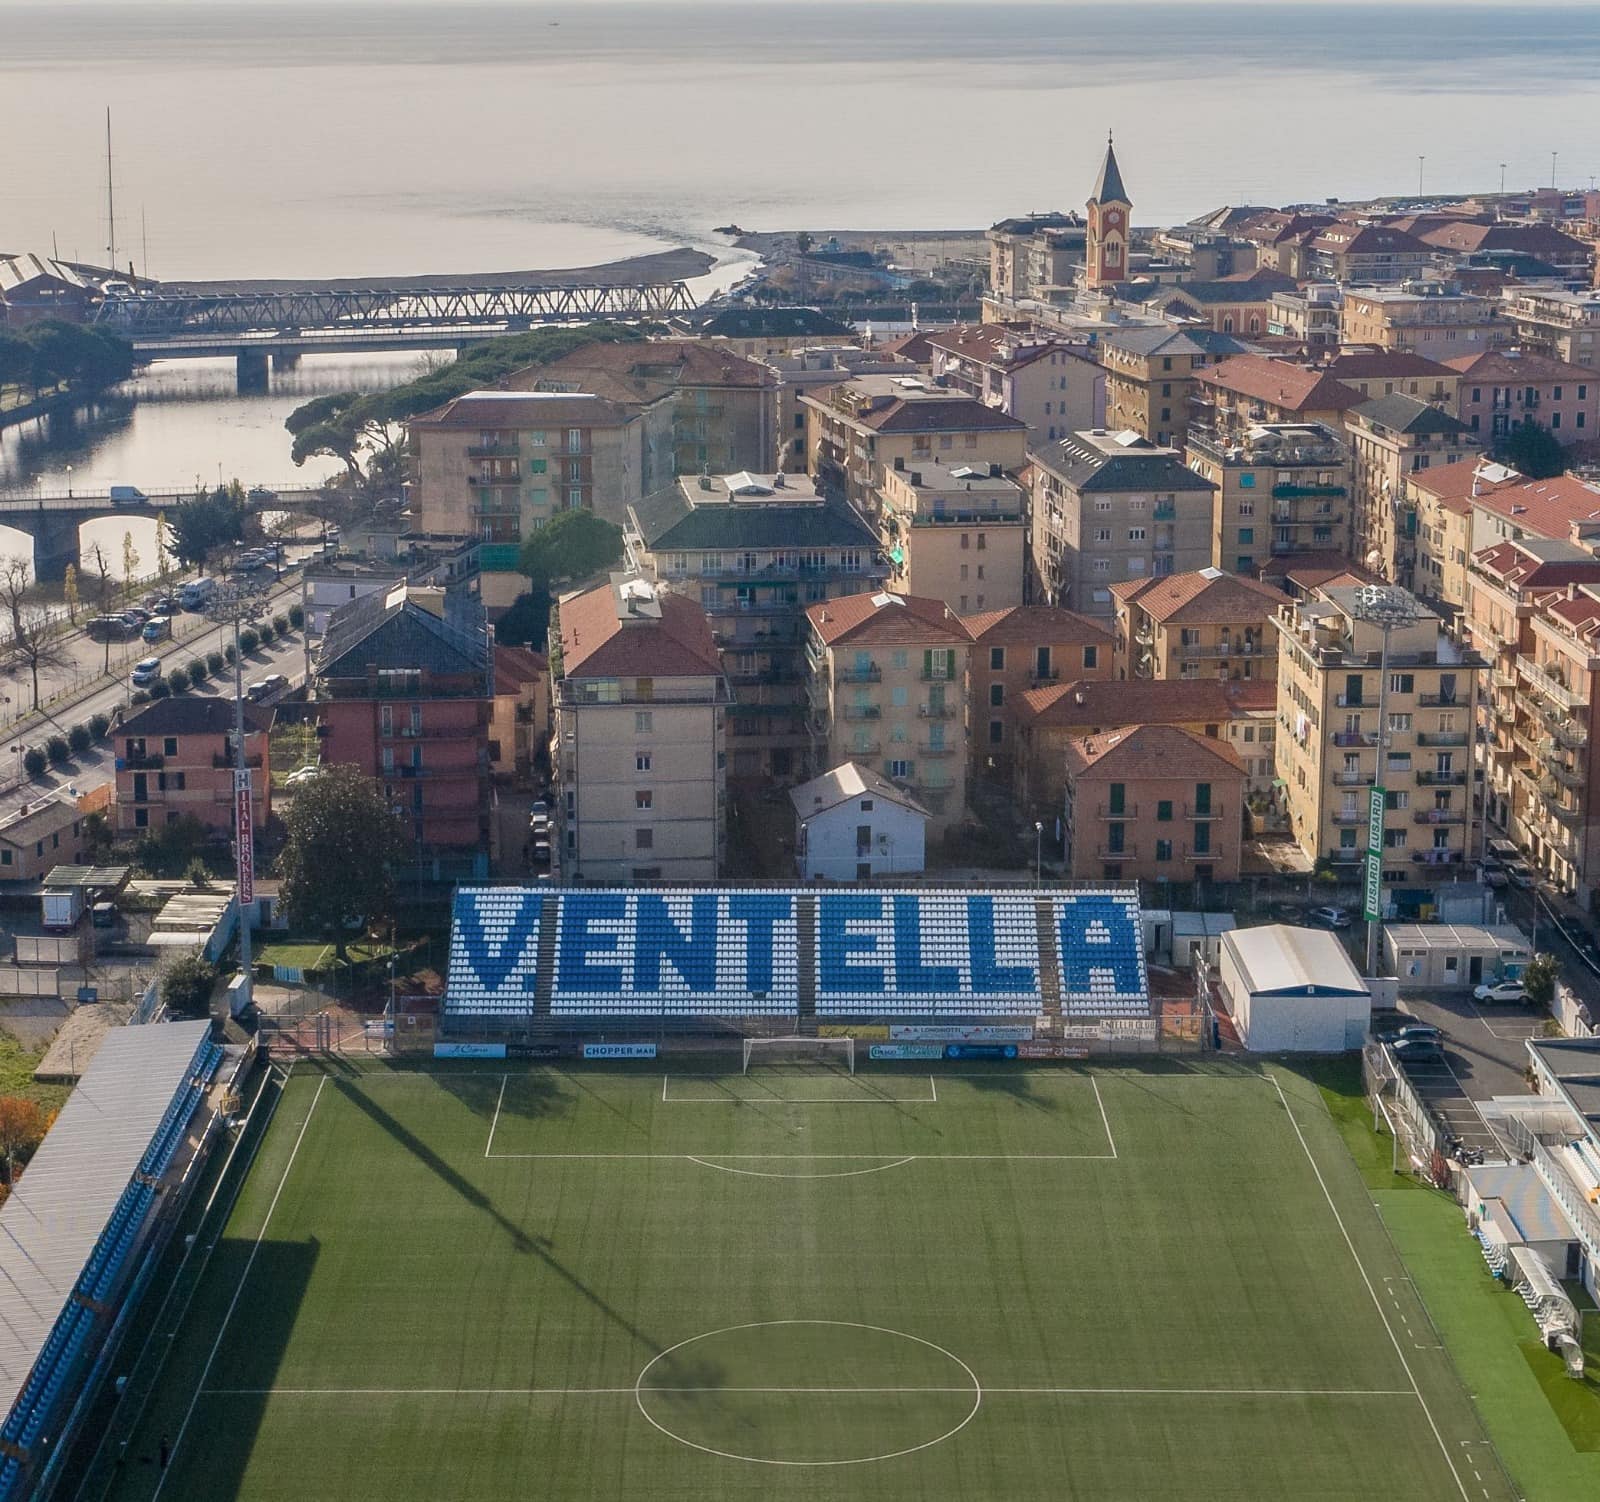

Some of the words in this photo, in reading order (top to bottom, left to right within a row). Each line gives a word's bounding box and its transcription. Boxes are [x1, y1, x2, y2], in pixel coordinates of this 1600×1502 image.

[239, 791, 249, 830] ITAL
[1371, 792, 1382, 849] LUSARDI
[240, 834, 251, 902] BROKERS
[1367, 858, 1378, 912] LUSARDI
[585, 1047, 634, 1055] CHOPPER
[636, 1047, 655, 1055] MAN
